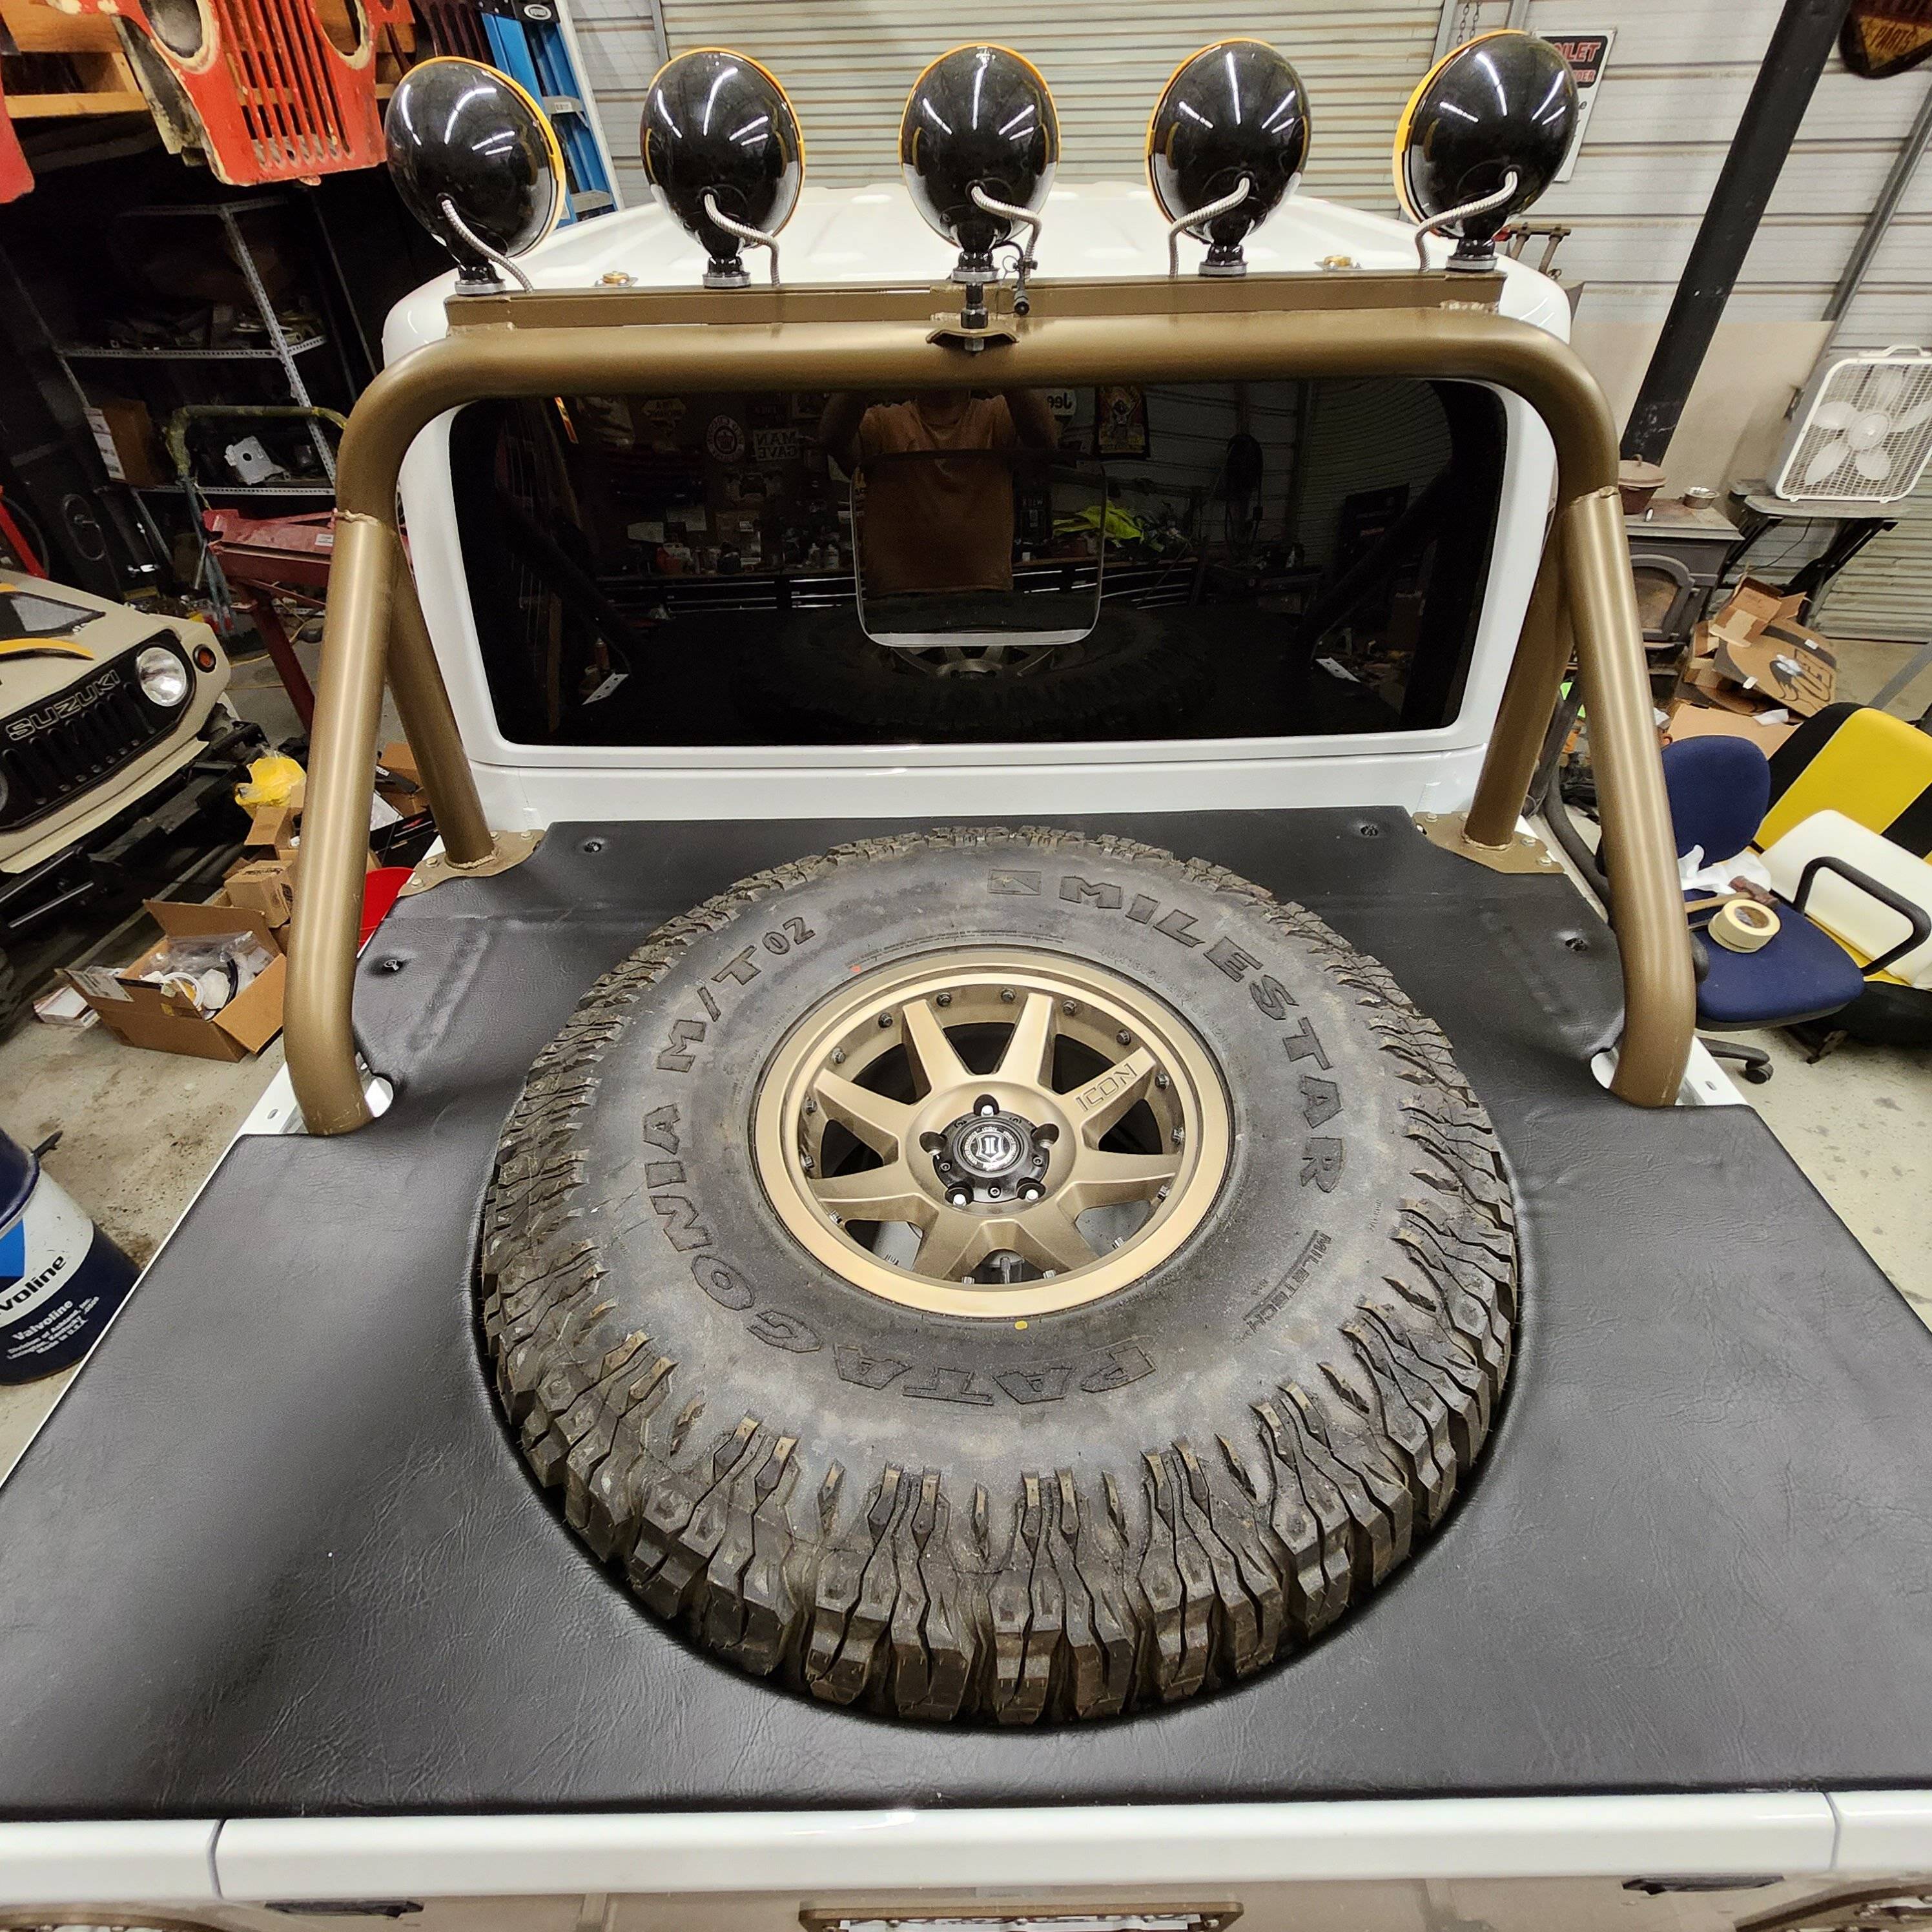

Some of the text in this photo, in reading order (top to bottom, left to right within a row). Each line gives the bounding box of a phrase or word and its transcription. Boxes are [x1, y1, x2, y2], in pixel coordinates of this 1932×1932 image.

[1554, 42, 1601, 61] ILET
[1572, 69, 1596, 82] DER
[6, 670, 120, 741] SUZUKI
[1059, 875, 1344, 1193] MILESTAR
[1076, 1063, 1138, 1111] ICON
[643, 1103, 1156, 1405] PATAGONIA
[0, 1255, 67, 1311] voline
[11, 1300, 73, 1340] Valvoline
